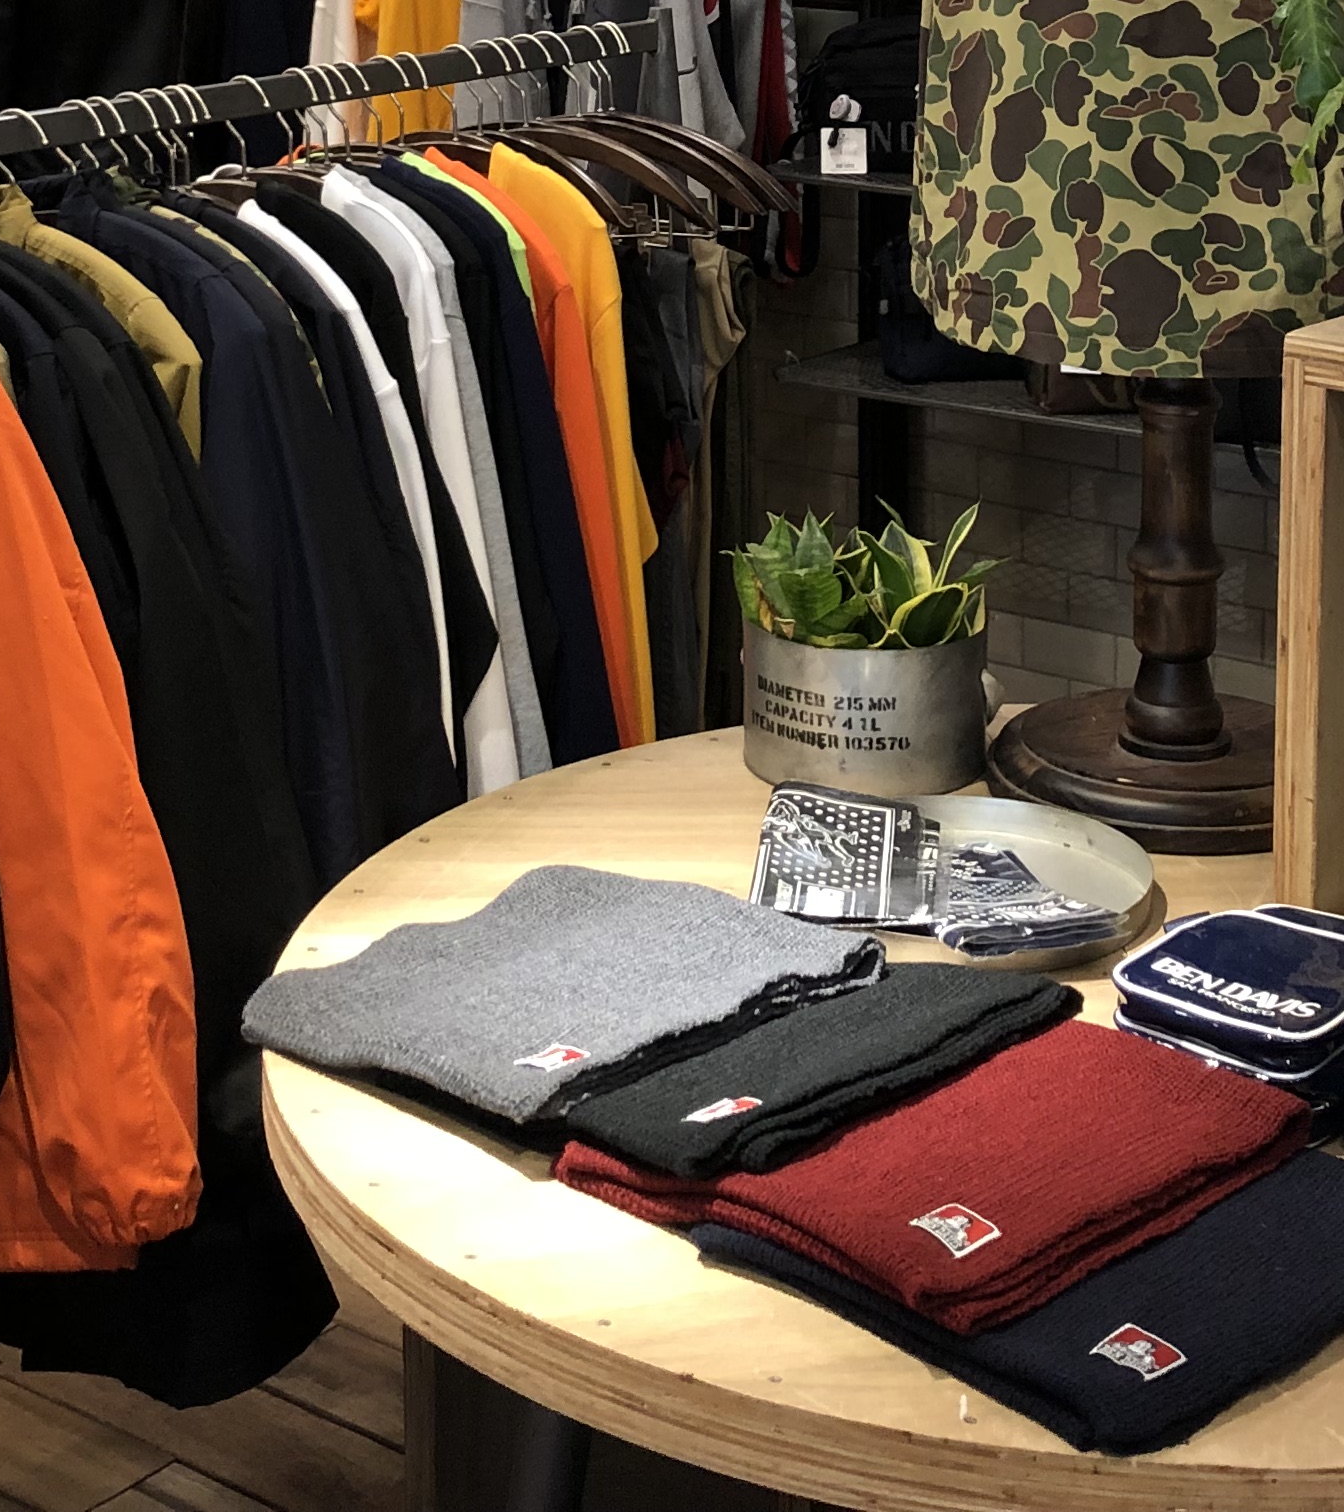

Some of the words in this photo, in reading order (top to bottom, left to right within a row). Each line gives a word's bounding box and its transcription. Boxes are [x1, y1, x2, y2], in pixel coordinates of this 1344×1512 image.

[757, 674, 826, 708] DIAMETER
[833, 696, 863, 711] 215
[868, 696, 897, 712] MM
[765, 699, 837, 729] CAPACITY
[777, 722, 840, 750] NUMBER
[844, 736, 911, 752] 103570
[1150, 956, 1226, 990] BEN
[1218, 981, 1322, 1019] DAVIS
[1166, 977, 1197, 992] SAN
[1197, 988, 1277, 1018] FRANCISCO
